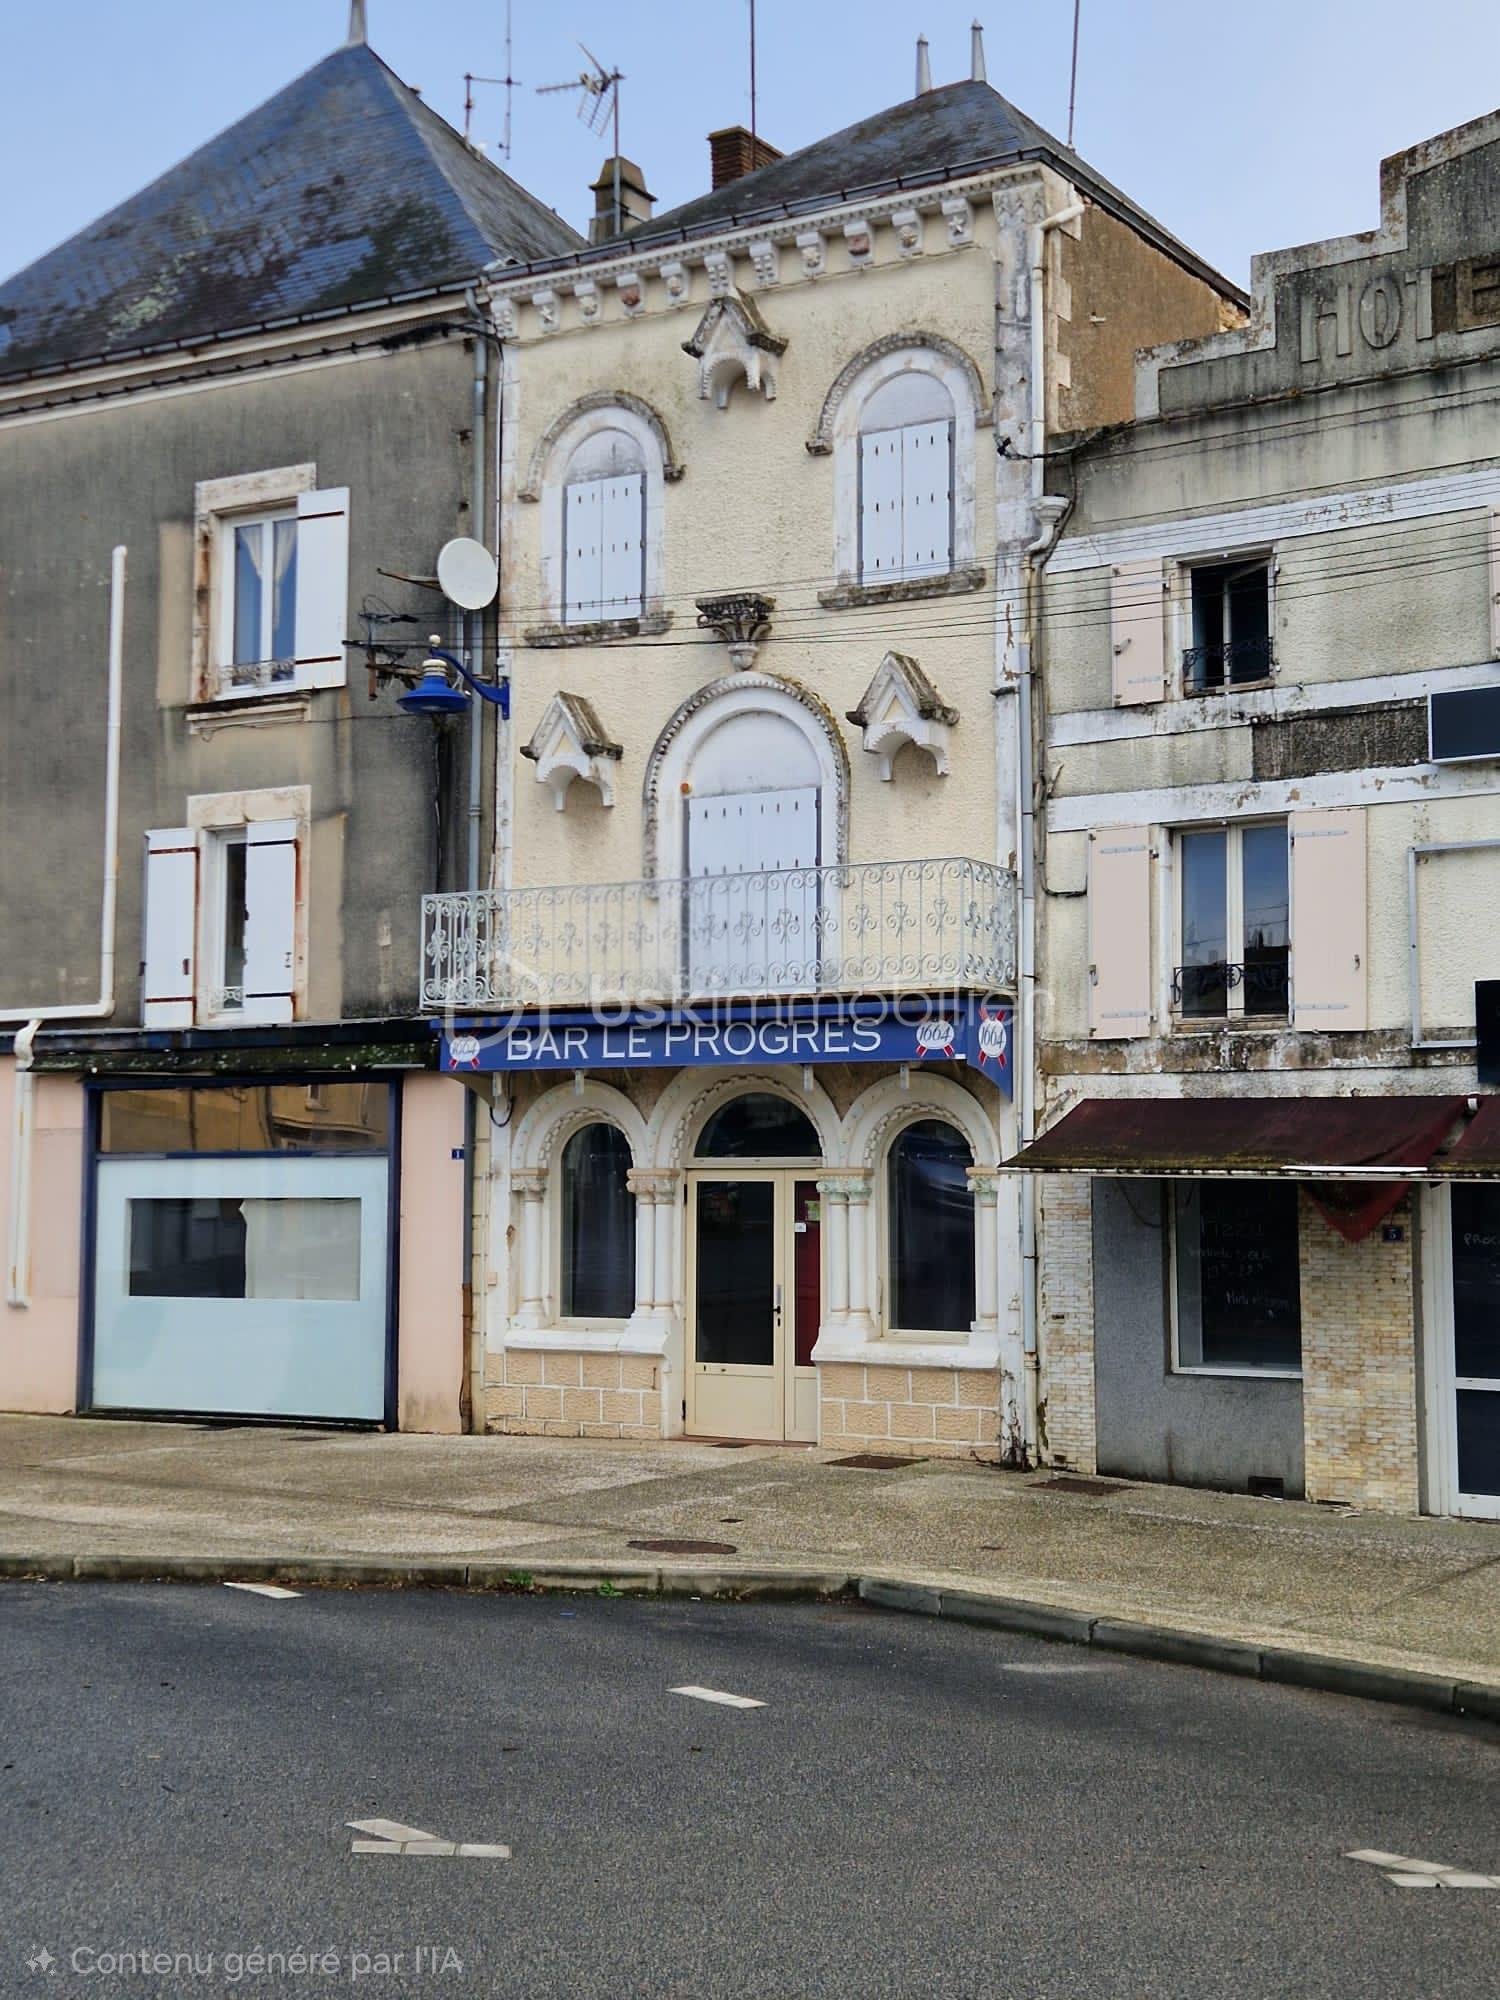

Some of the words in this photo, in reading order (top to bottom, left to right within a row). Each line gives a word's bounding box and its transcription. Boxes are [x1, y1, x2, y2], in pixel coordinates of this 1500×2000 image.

[506, 1027, 589, 1060] BAR
[602, 1024, 652, 1058] LE
[665, 1017, 882, 1057] PROGRES
[919, 1023, 951, 1042] 1664
[980, 1023, 1004, 1048] 1664
